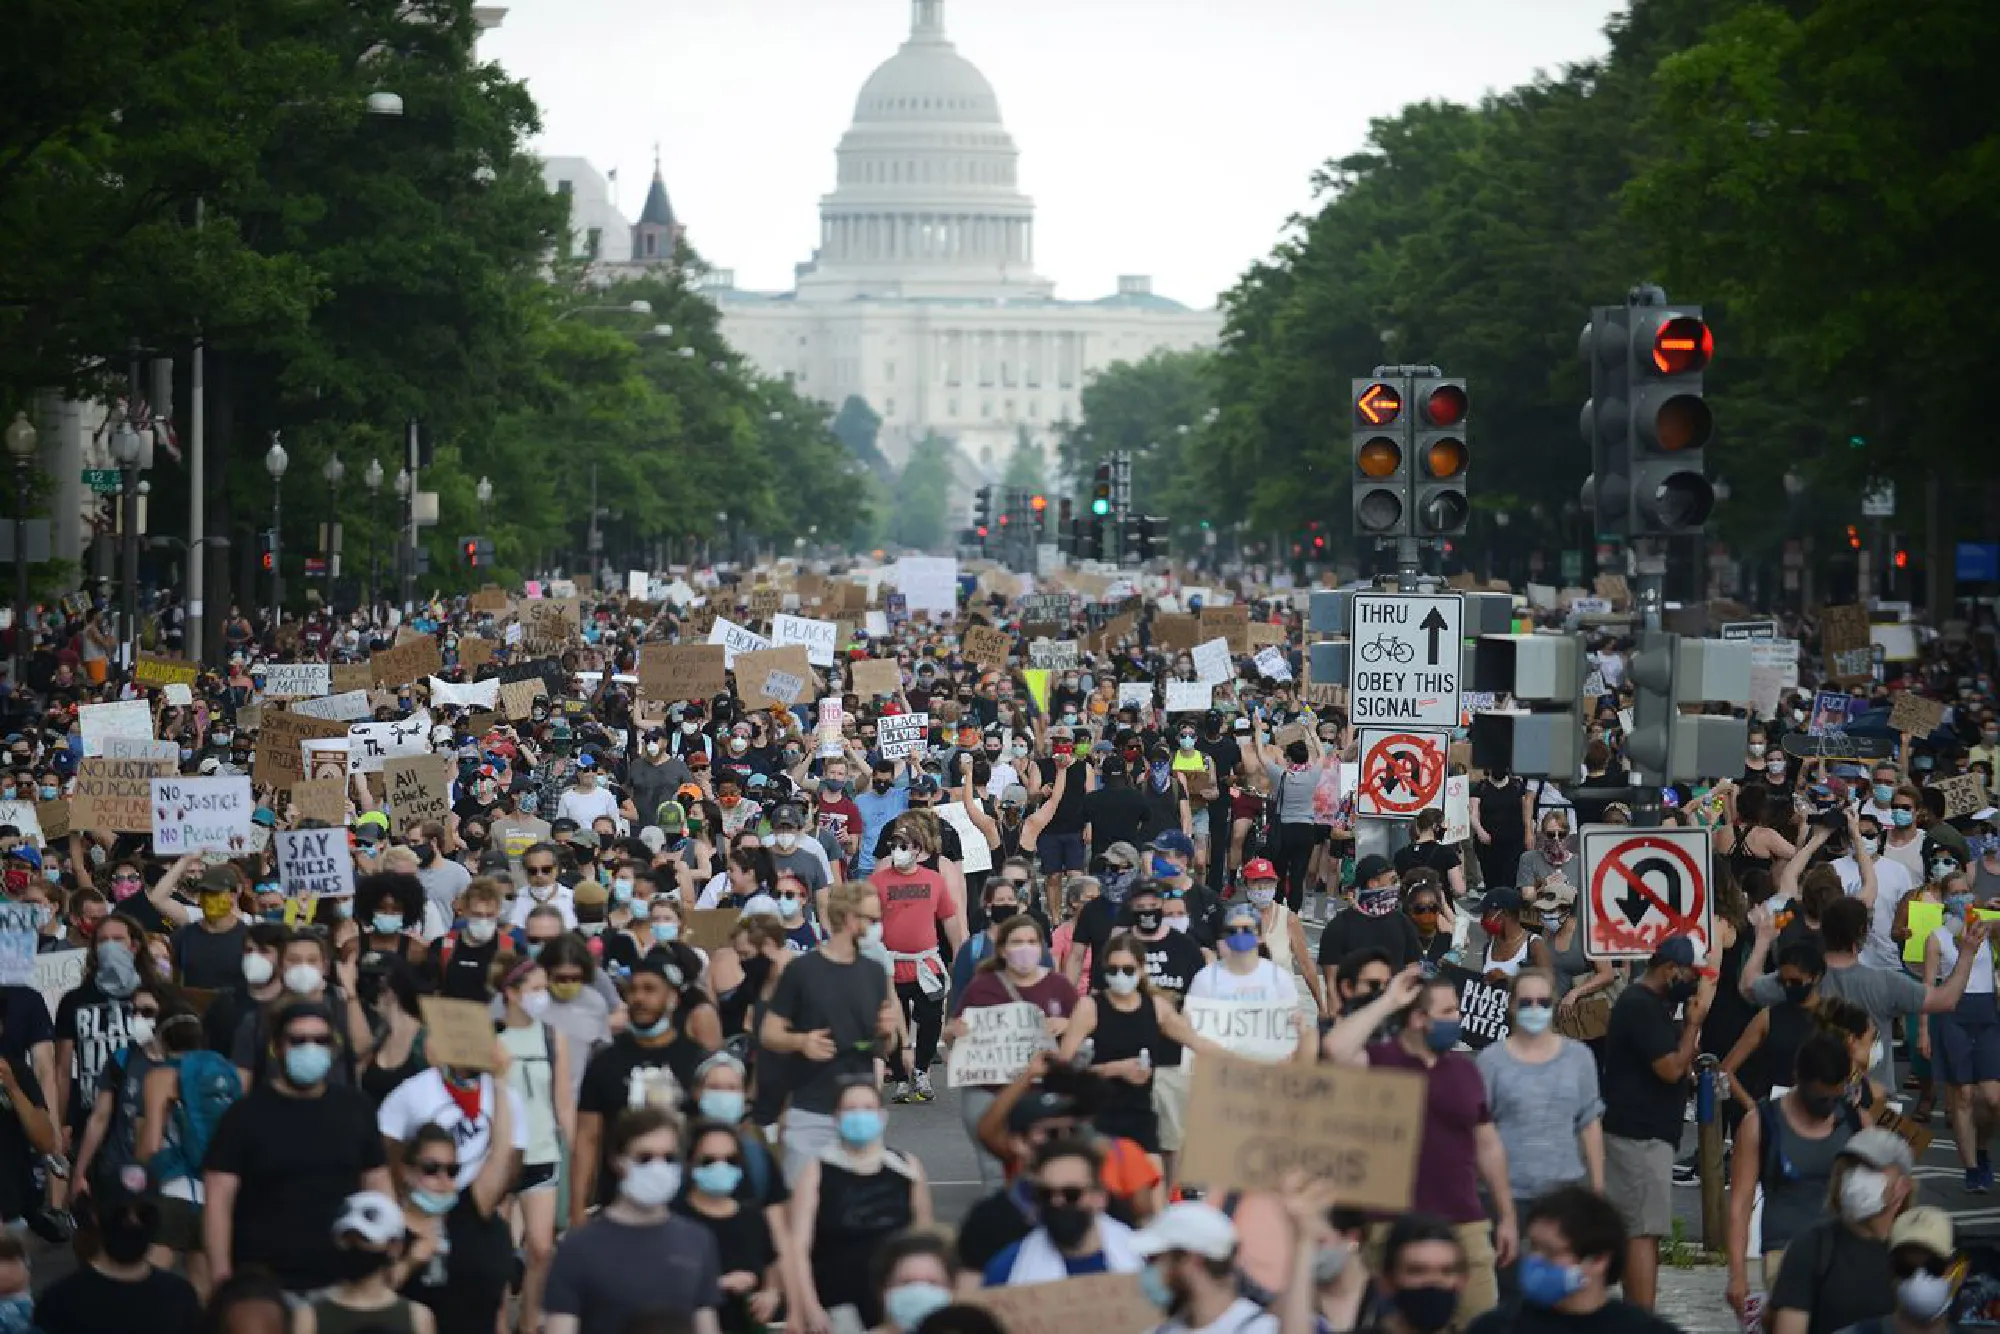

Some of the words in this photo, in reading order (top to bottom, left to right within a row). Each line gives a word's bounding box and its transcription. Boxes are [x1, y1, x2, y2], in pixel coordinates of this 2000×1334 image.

[1361, 604, 1408, 623] THRU
[267, 666, 295, 679] BLACK
[298, 666, 326, 679] LIVES
[1358, 672, 1406, 692] OBEY
[1414, 673, 1454, 693] THIS
[1358, 698, 1422, 717] SIGNAL
[880, 715, 923, 730] BLACK
[882, 727, 920, 742] LIVES
[363, 738, 387, 756] The
[80, 761, 106, 777] NO
[77, 781, 103, 796] NO
[108, 781, 150, 797] PEAC
[160, 785, 181, 801] NO
[160, 828, 178, 844] NO
[288, 832, 329, 860] SAY
[284, 857, 337, 876] THEIR
[1463, 979, 1511, 1009] BLACK
[76, 1002, 133, 1039] BLA
[1461, 999, 1506, 1023] LIVES
[1192, 1007, 1298, 1040] JUSTICE
[1459, 1013, 1509, 1041] ATTER
